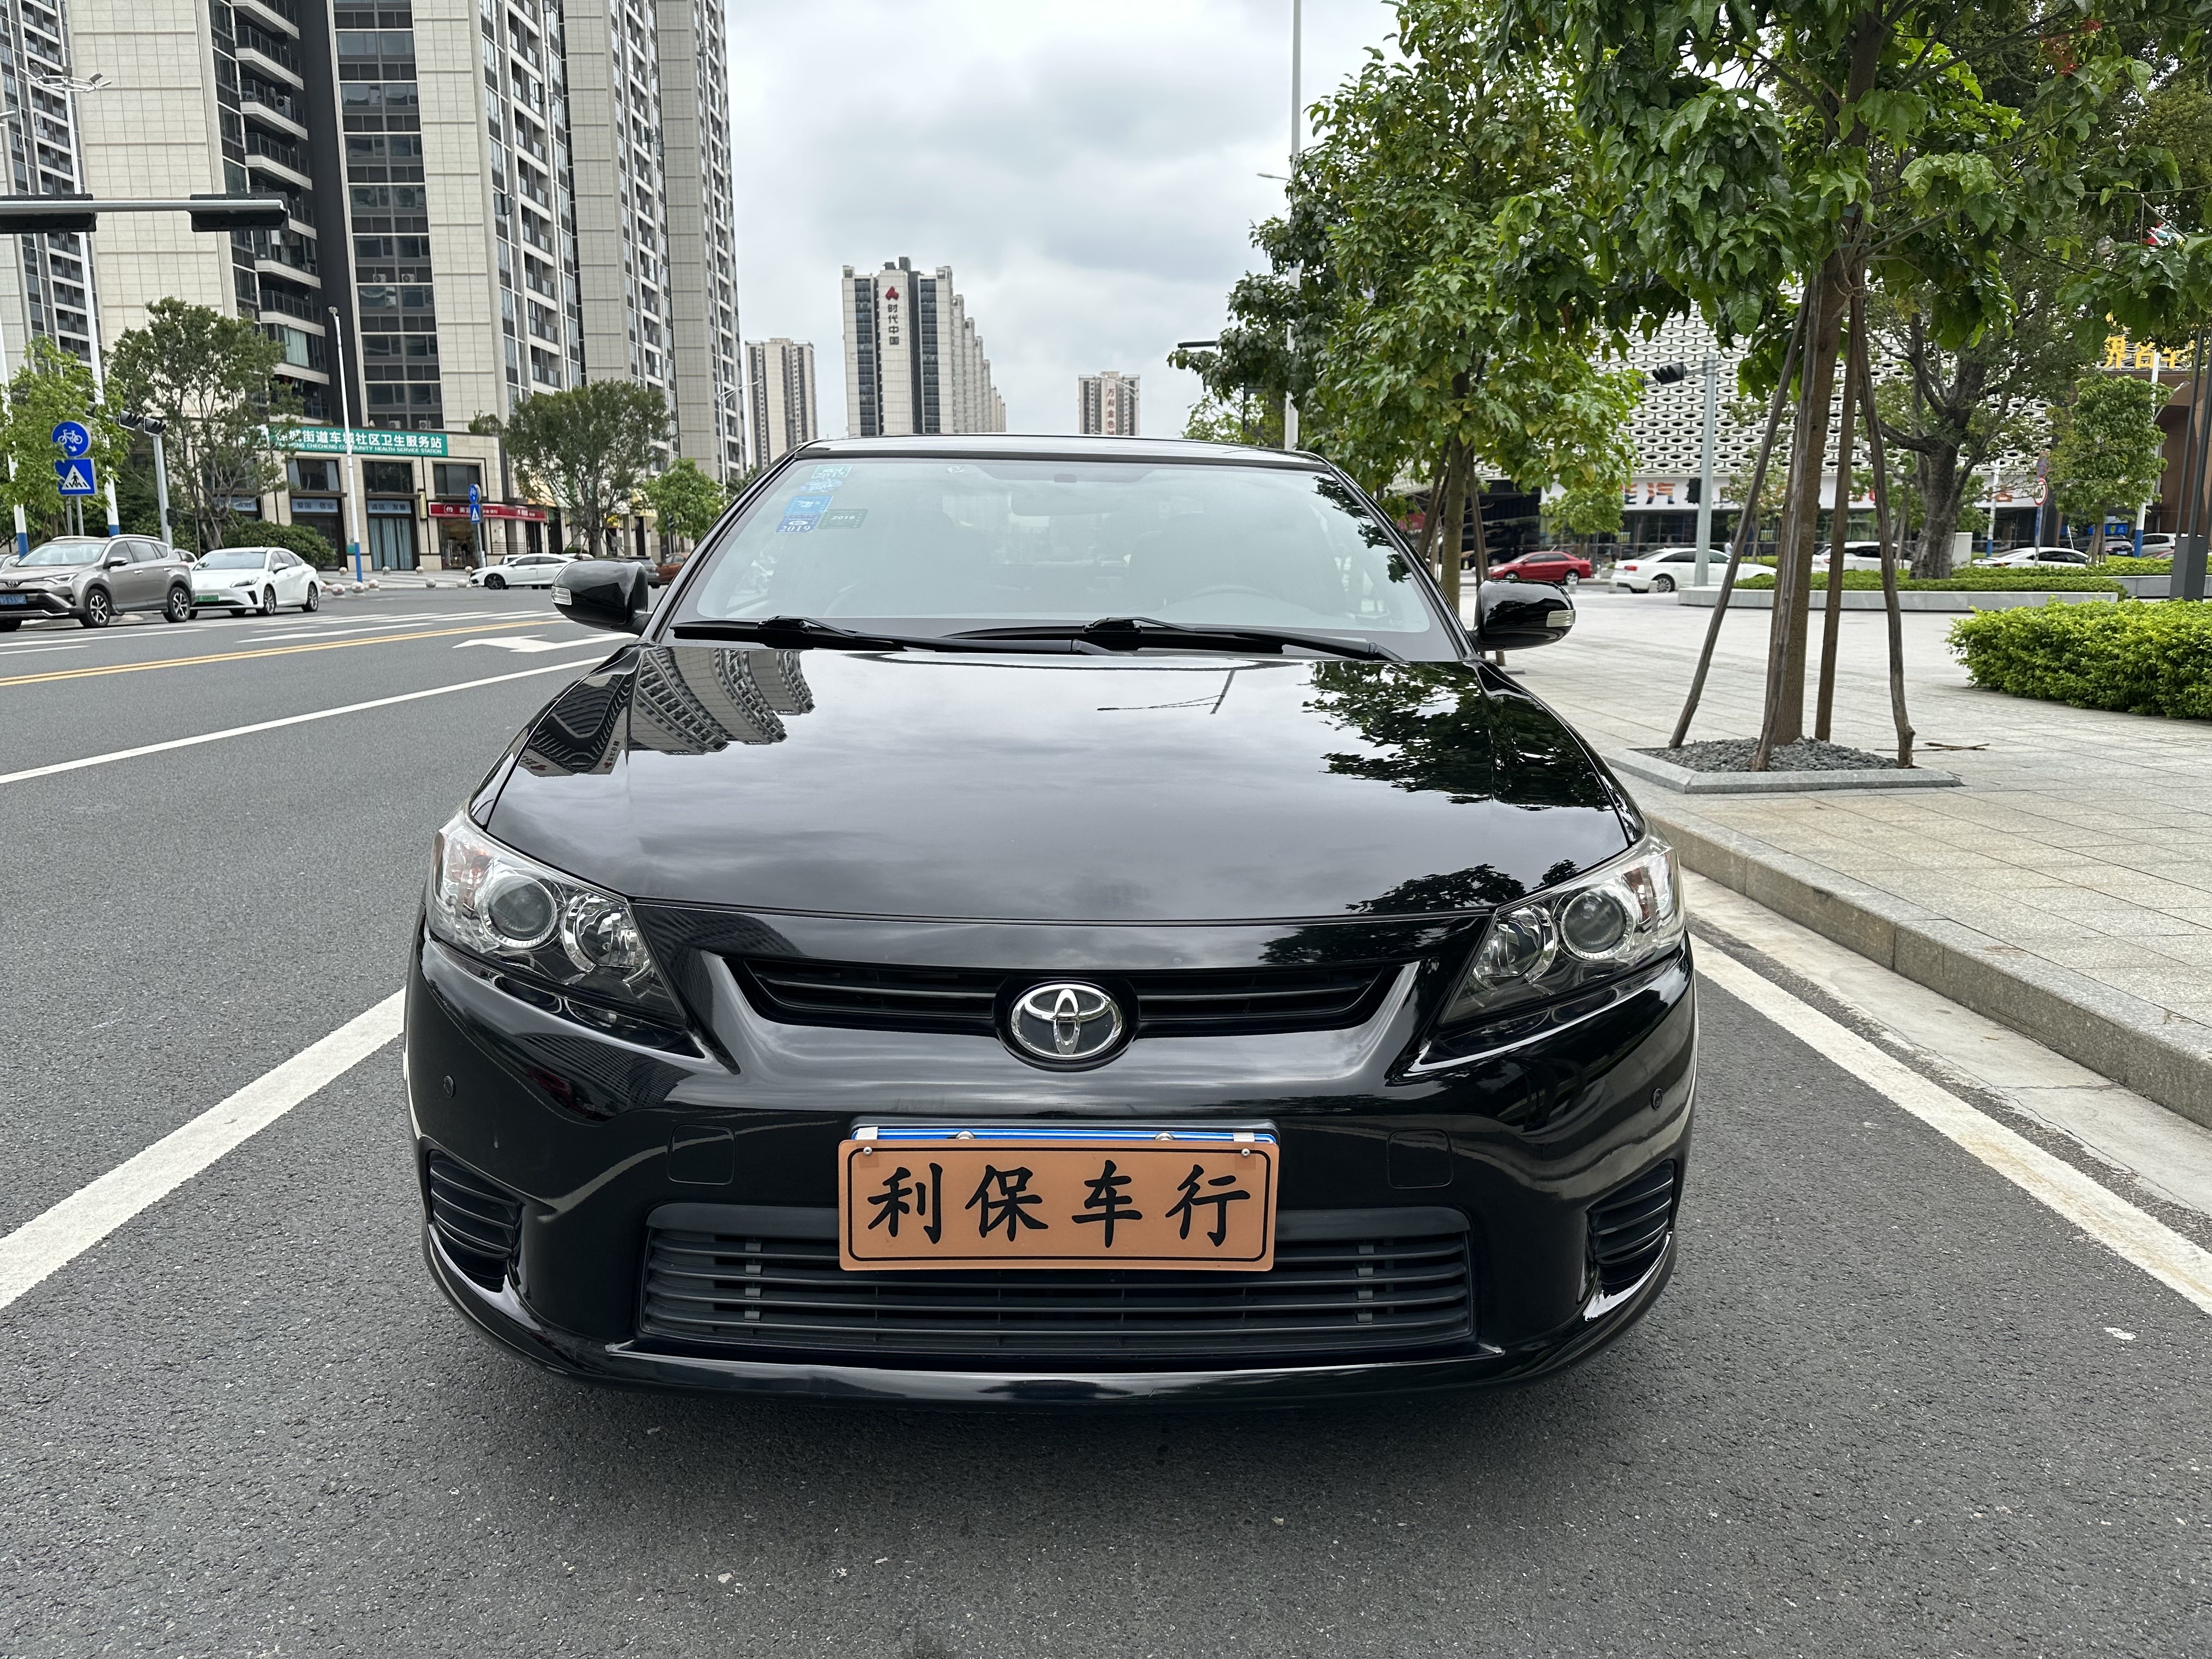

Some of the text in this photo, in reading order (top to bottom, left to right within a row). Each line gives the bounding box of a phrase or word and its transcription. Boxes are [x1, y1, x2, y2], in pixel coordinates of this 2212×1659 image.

[888, 303, 900, 345] 时代中国
[867, 1159, 1251, 1248] 利保车行
